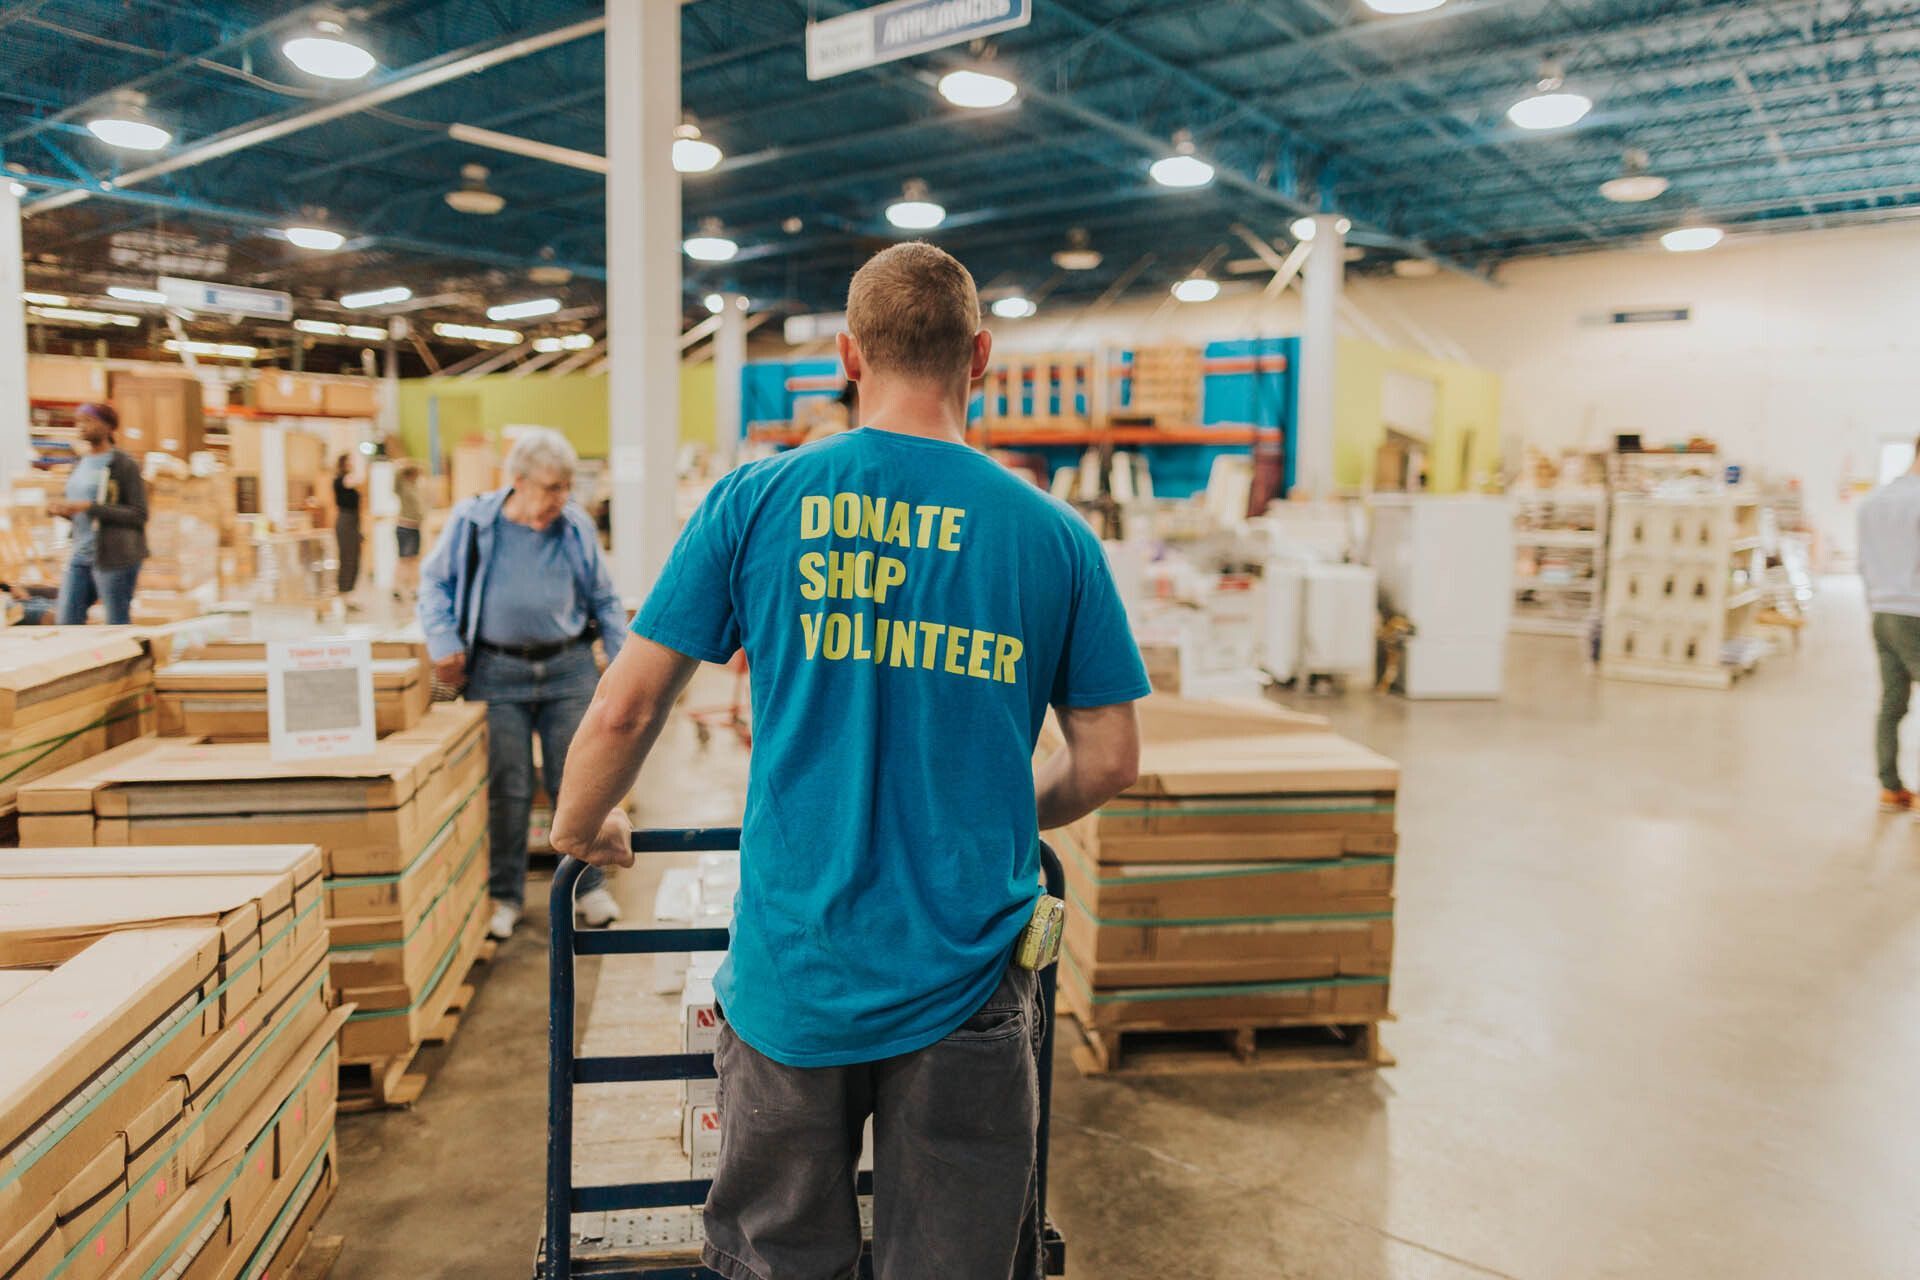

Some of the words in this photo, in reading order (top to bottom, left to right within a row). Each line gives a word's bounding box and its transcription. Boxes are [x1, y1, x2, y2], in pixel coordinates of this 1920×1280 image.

[801, 492, 965, 551] DONATE
[798, 551, 906, 604] SHOP
[800, 612, 1023, 684] VOLUNTEER
